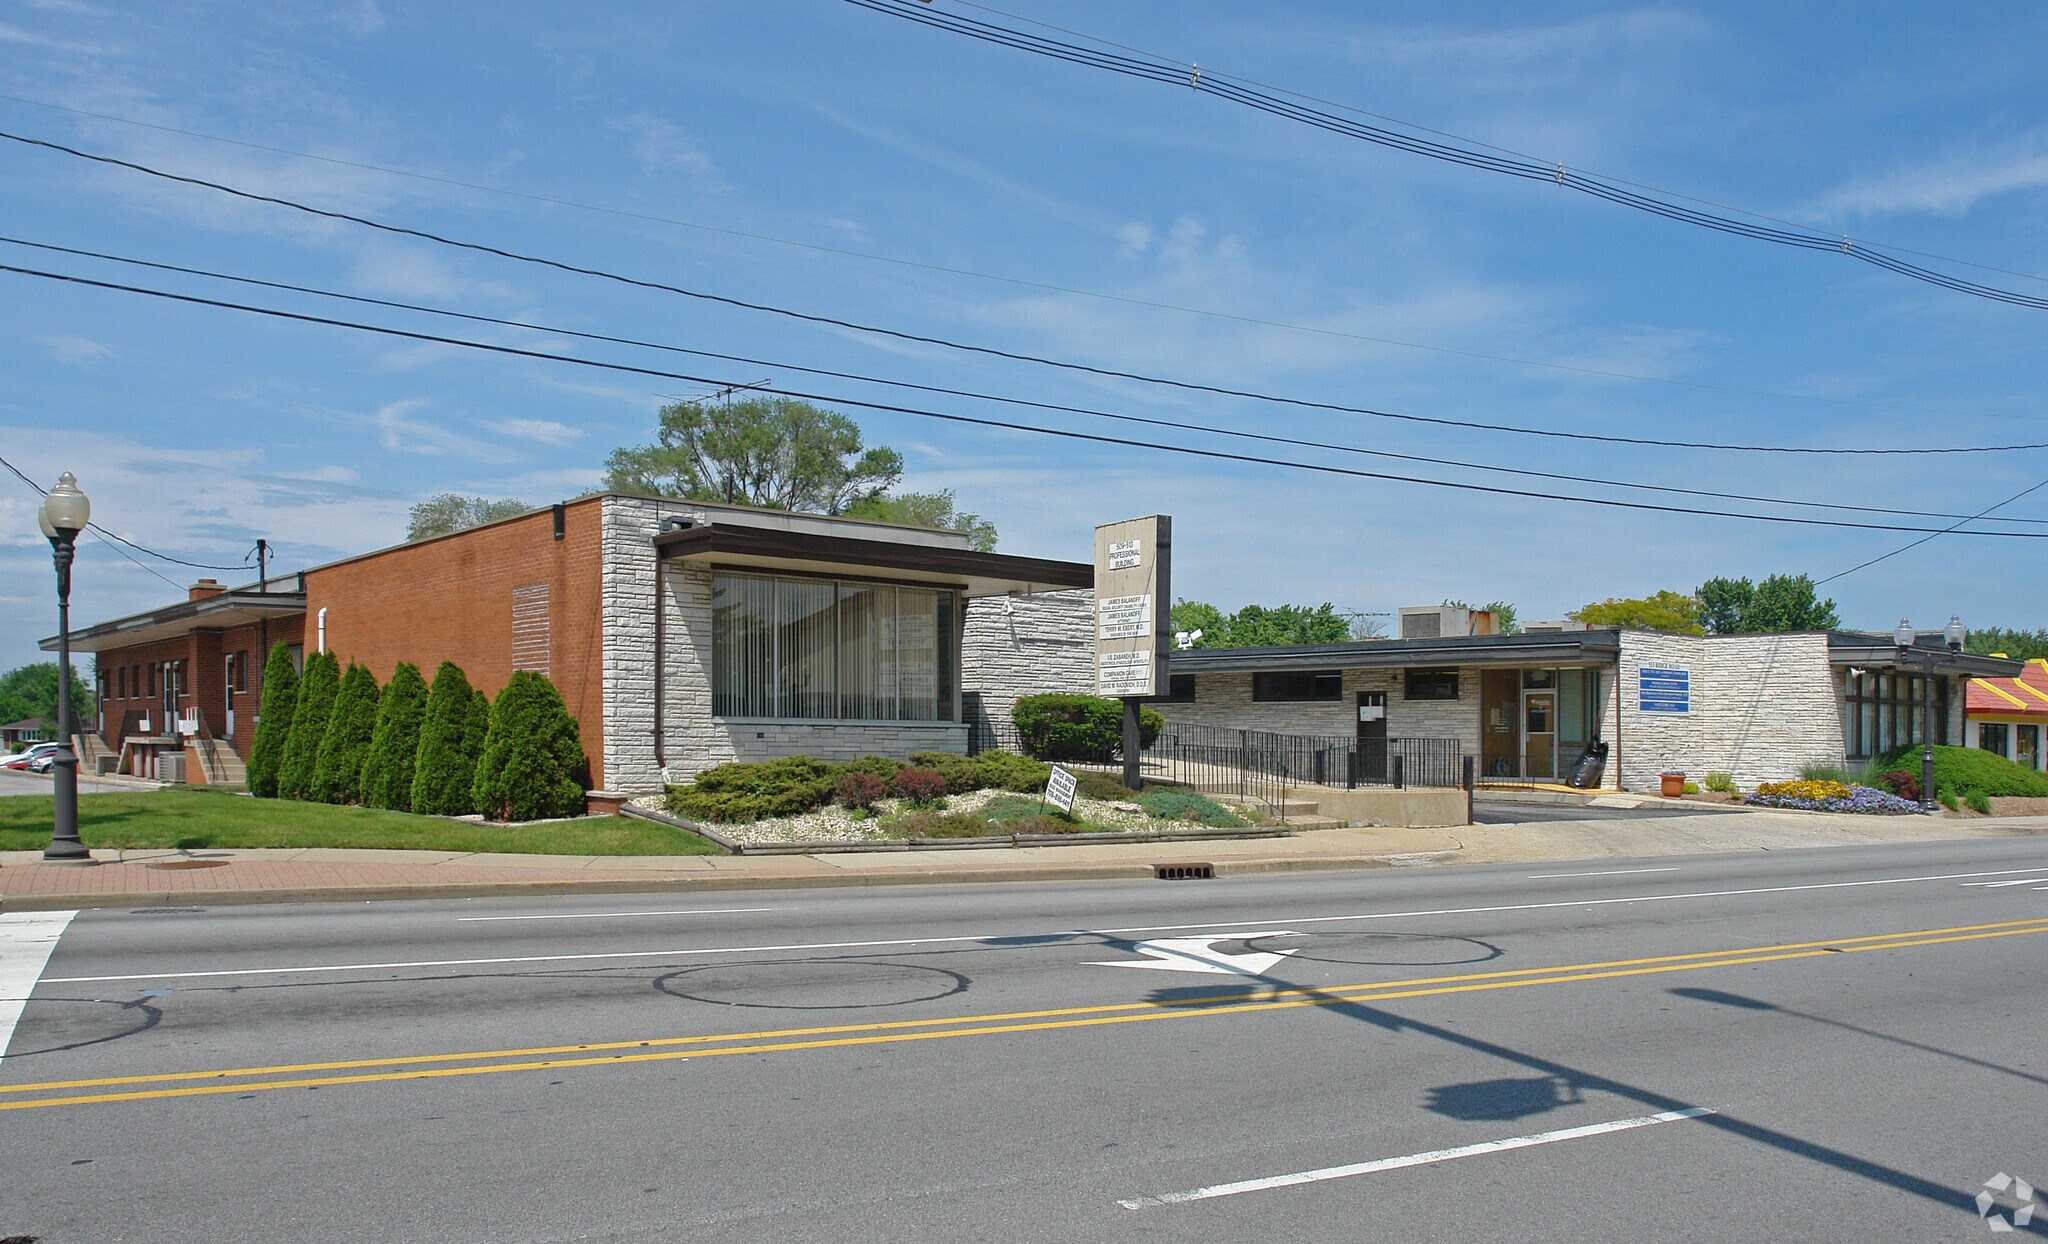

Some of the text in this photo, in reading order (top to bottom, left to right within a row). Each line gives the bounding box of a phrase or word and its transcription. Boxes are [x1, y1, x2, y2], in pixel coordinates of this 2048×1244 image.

[1110, 549, 1140, 560] PROFESSIONAL
[1115, 558, 1134, 568] BUILDING
[1053, 769, 1064, 780] OFFICE
[1053, 778, 1071, 793] AVAILABLE
